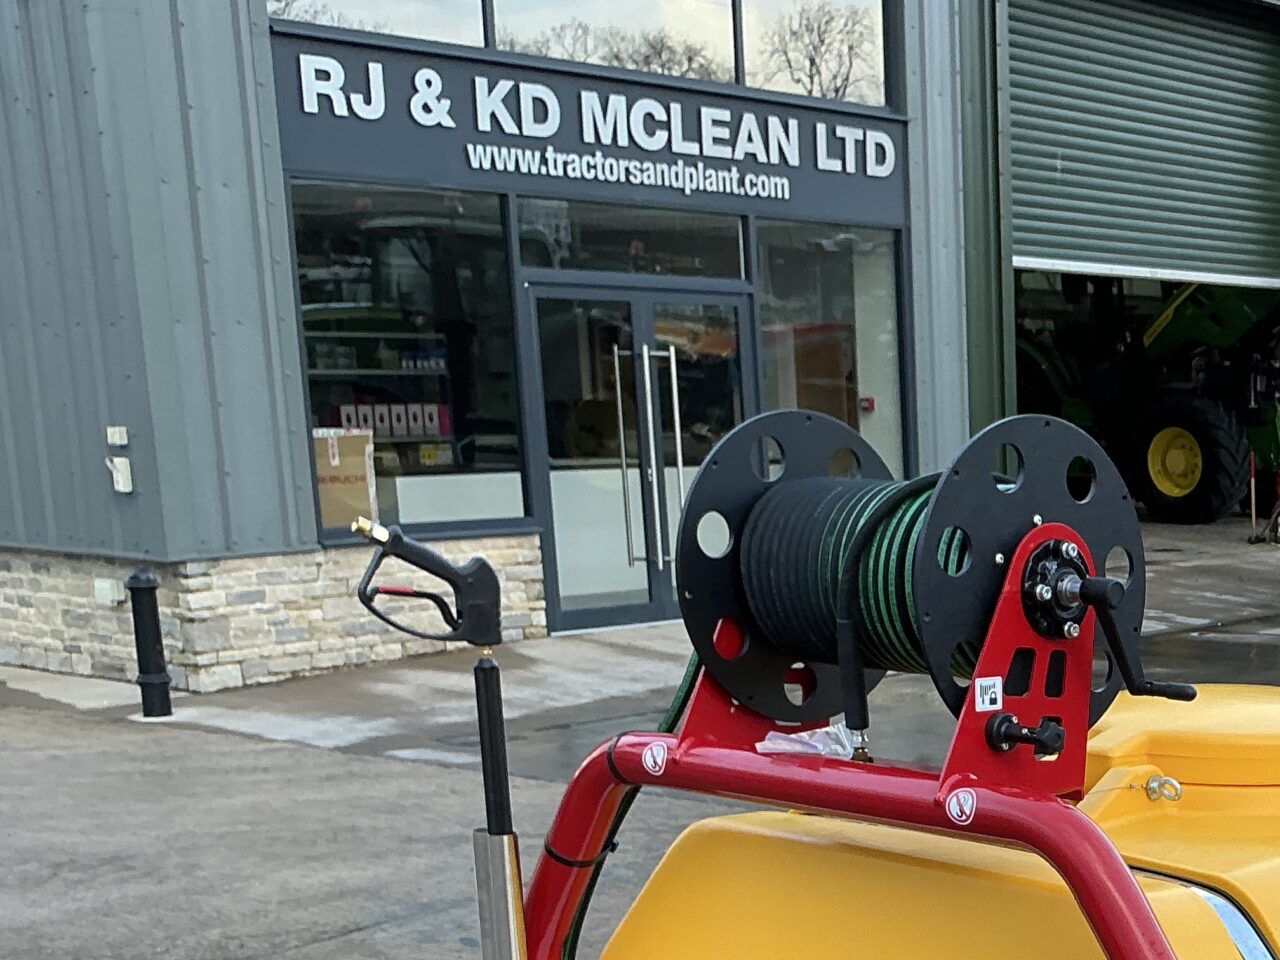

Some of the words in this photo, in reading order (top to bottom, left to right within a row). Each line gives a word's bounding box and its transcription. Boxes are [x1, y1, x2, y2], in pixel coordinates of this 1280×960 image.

[299, 53, 386, 121] RJ
[409, 67, 457, 128] &
[474, 75, 561, 138] KD
[580, 89, 800, 167] MCLEAN
[816, 121, 896, 178] LTD
[466, 142, 790, 200] www.tractorsandplant.com
